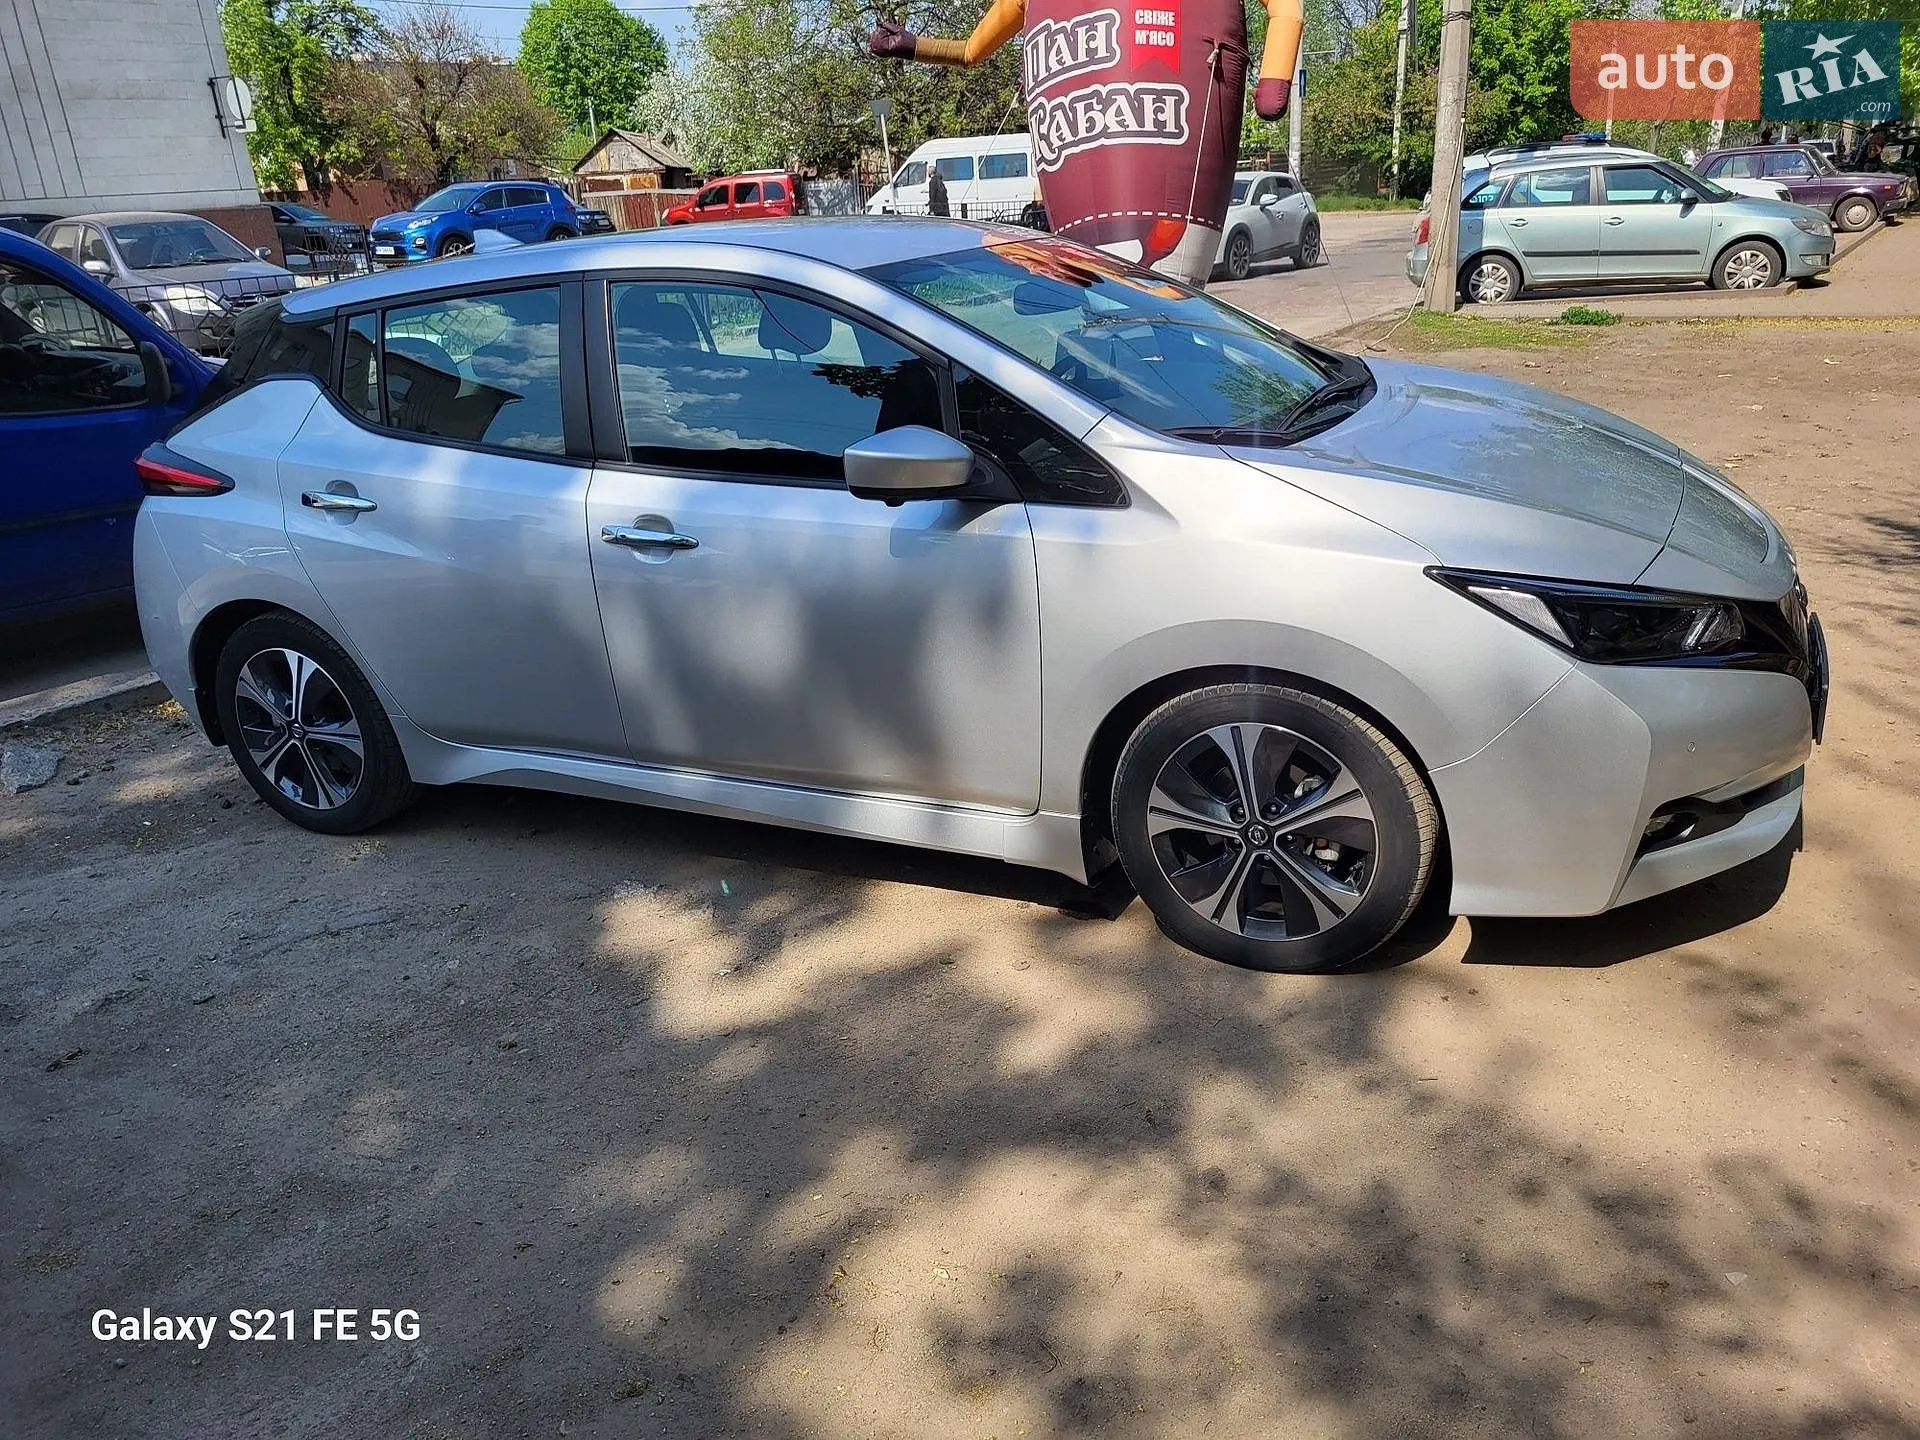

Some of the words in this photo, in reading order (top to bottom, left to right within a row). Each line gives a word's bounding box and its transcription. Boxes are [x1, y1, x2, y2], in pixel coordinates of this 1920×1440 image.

[1135, 9, 1176, 27] СВІЖЕ
[1026, 20, 1114, 90] ПАН
[1030, 93, 1180, 162] КАБАН
